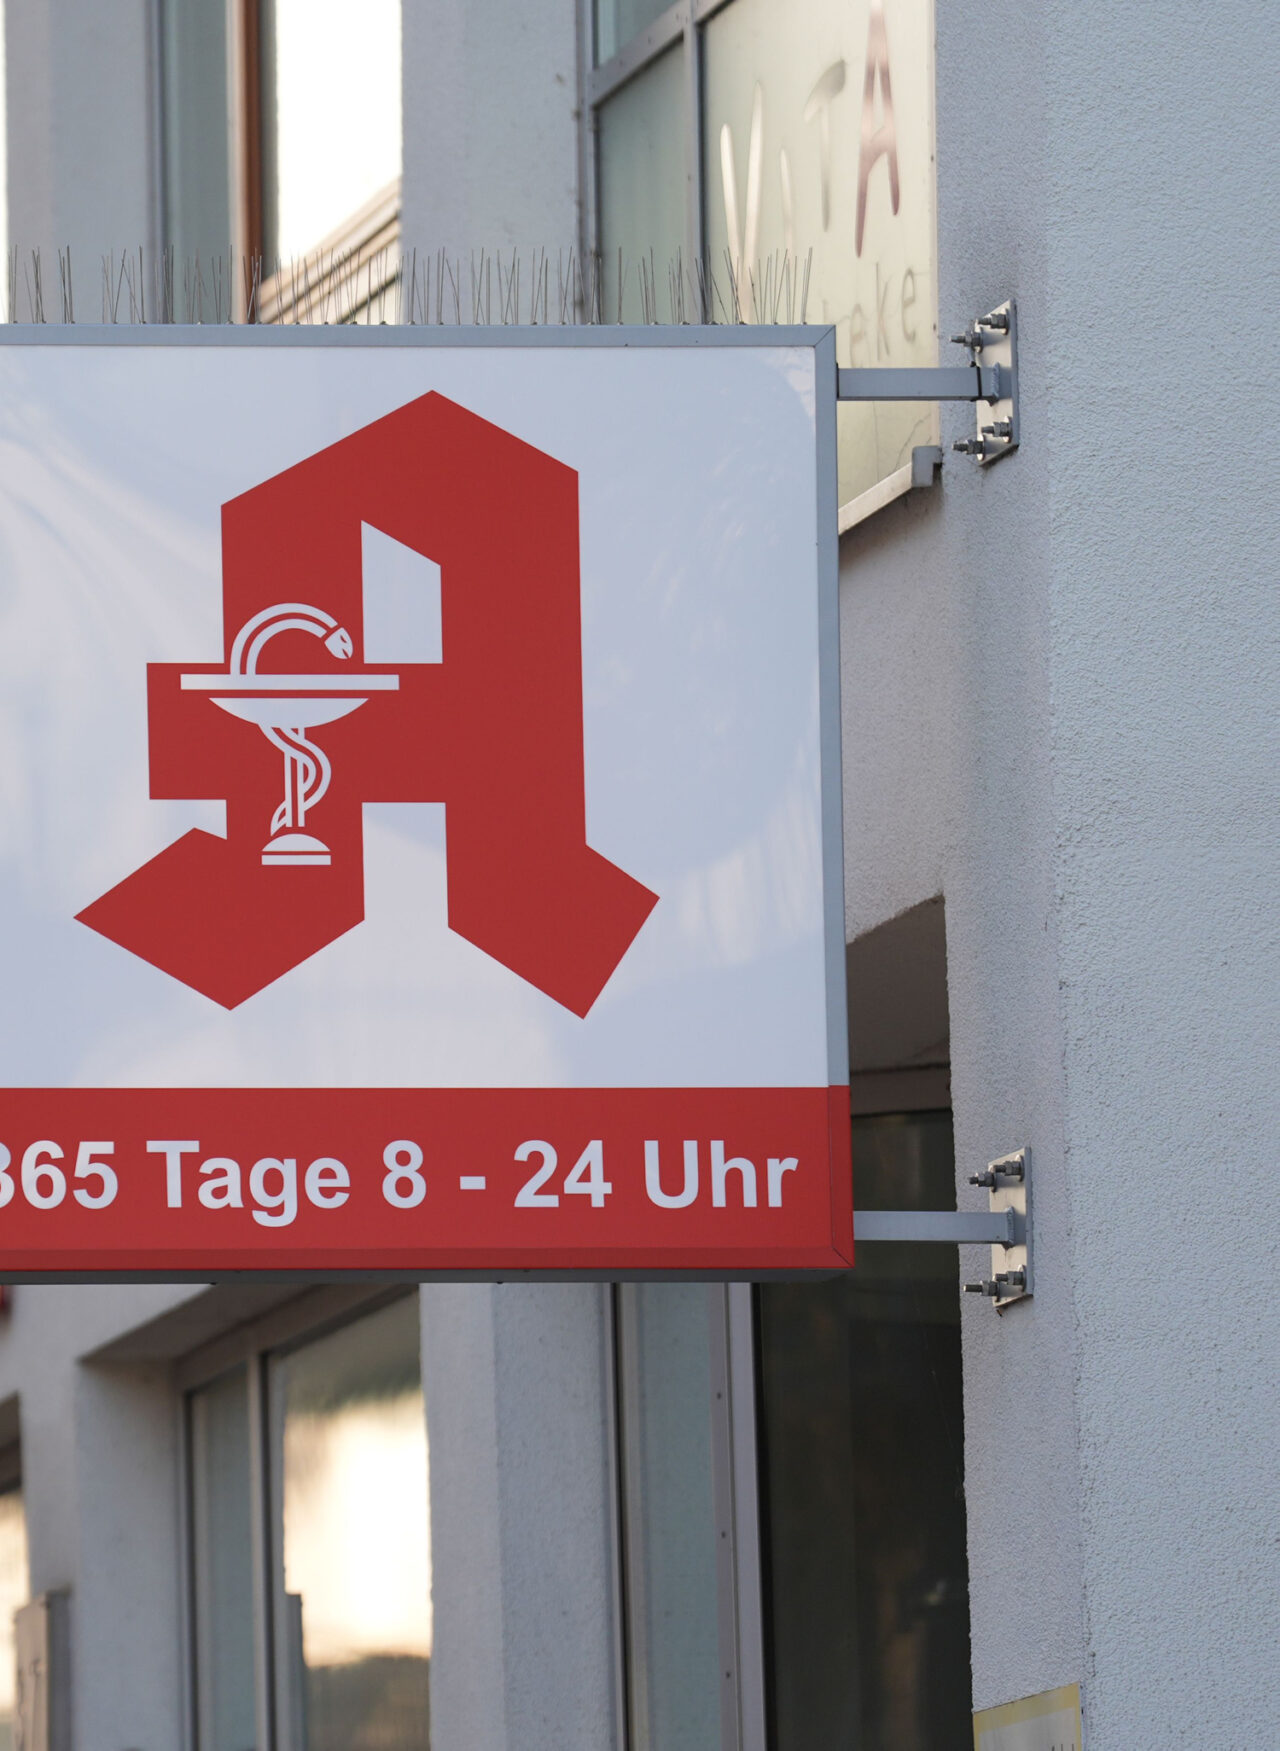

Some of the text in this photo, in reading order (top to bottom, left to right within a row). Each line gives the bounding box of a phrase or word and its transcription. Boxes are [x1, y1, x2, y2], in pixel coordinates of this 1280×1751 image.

[146, 1140, 351, 1228] Tage
[382, 1139, 427, 1209] 8
[513, 1139, 613, 1208] 24
[644, 1139, 799, 1209] Uhr
